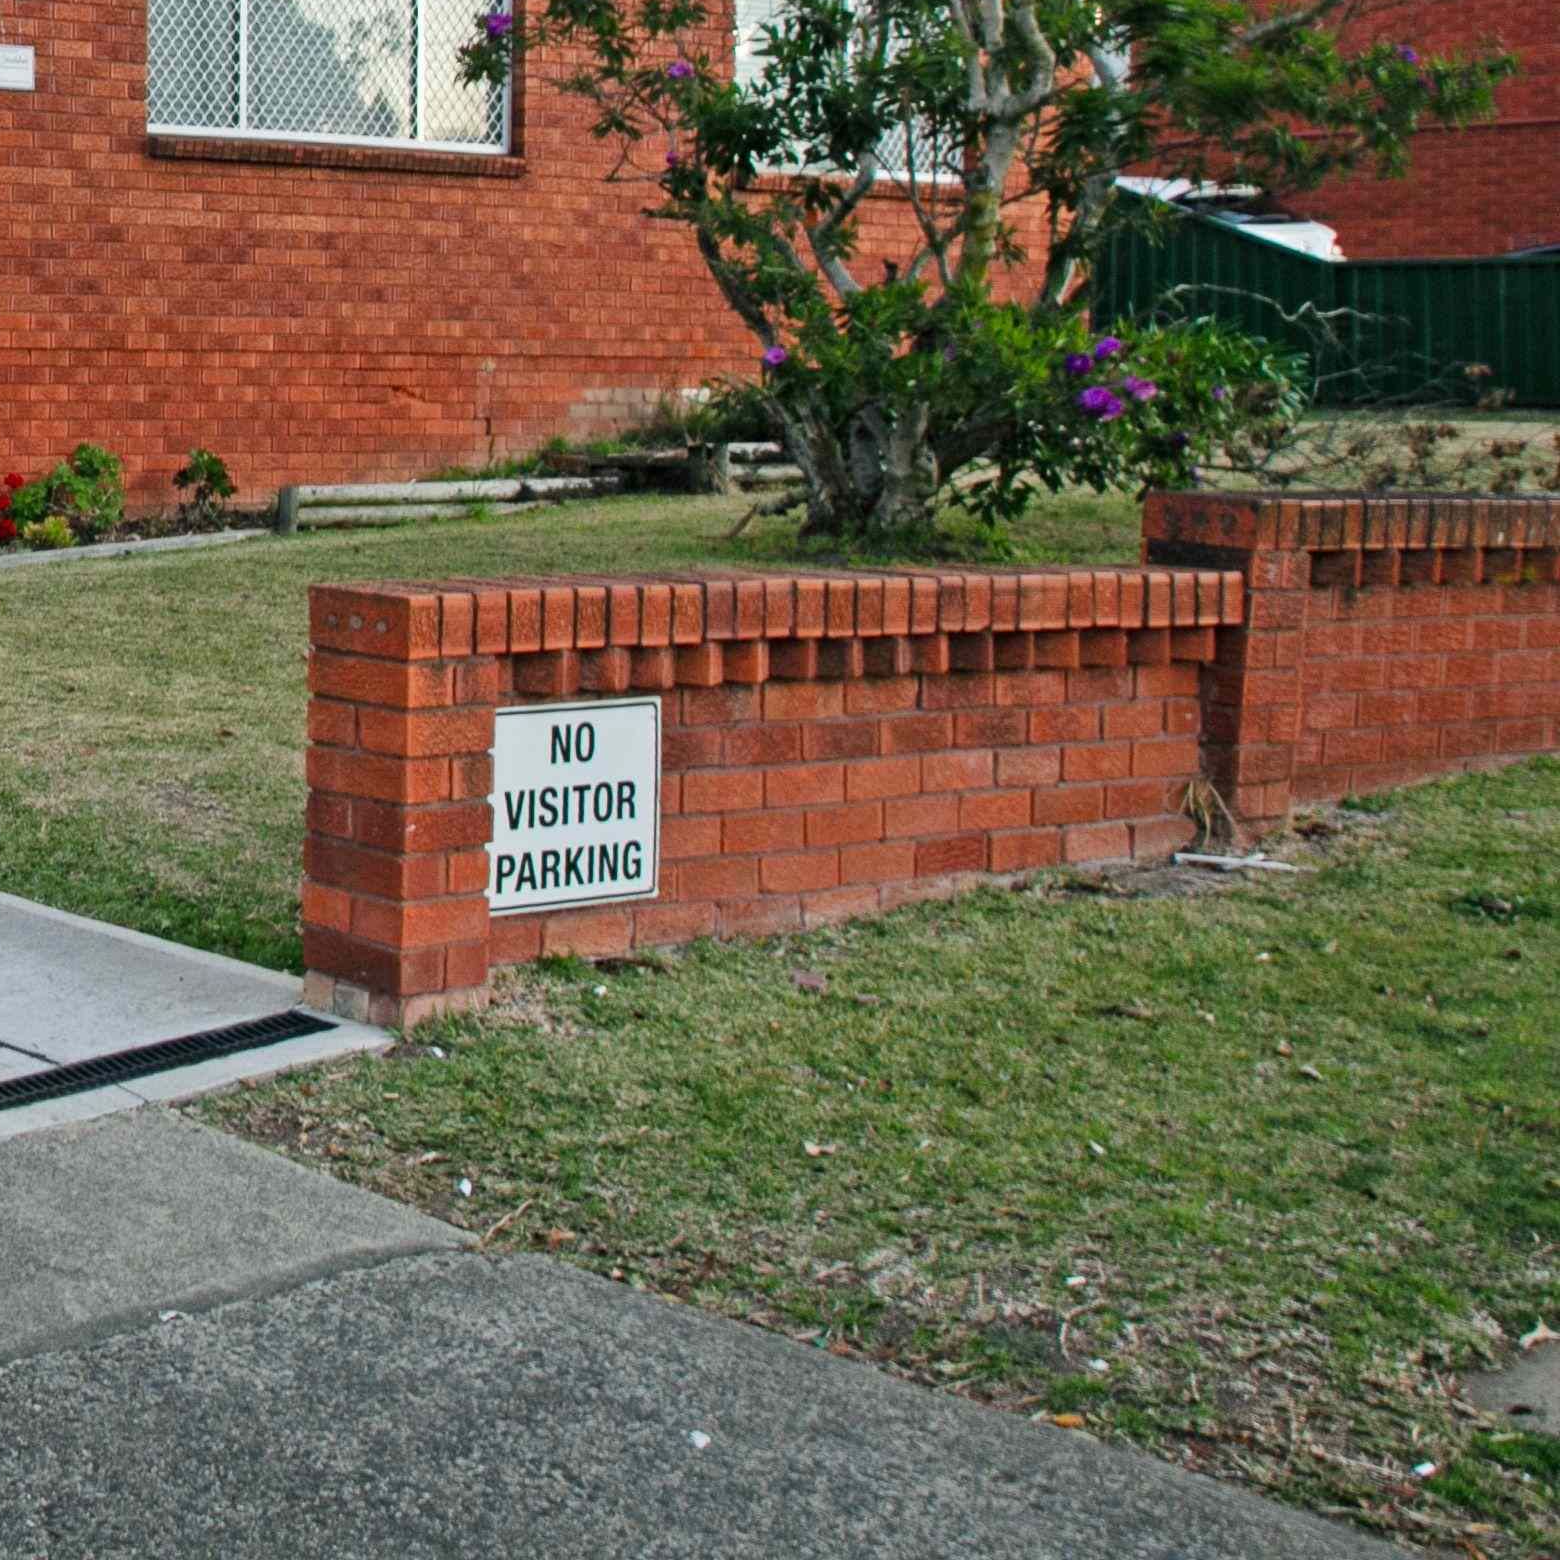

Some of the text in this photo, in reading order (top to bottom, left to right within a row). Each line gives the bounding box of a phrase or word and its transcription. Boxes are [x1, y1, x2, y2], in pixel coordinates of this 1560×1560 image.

[550, 721, 596, 764] NO
[504, 780, 637, 831] VISITOR
[495, 840, 642, 895] PARKING
